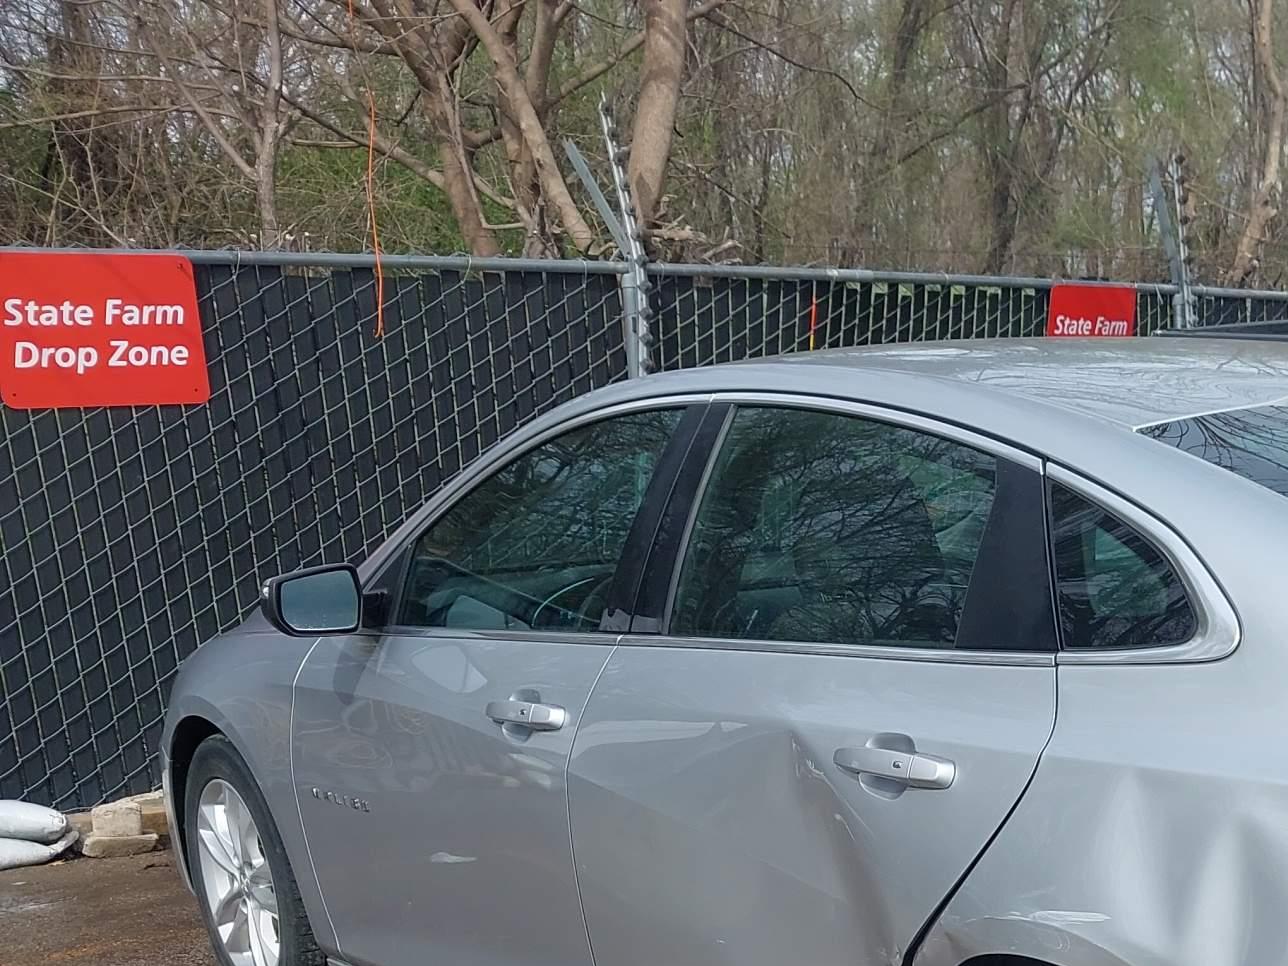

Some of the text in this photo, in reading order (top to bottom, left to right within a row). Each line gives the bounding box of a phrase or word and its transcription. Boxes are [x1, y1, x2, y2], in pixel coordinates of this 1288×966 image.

[4, 298, 184, 326] State Farm
[1053, 315, 1128, 336] State Farm
[14, 340, 189, 375] Drop Zone
